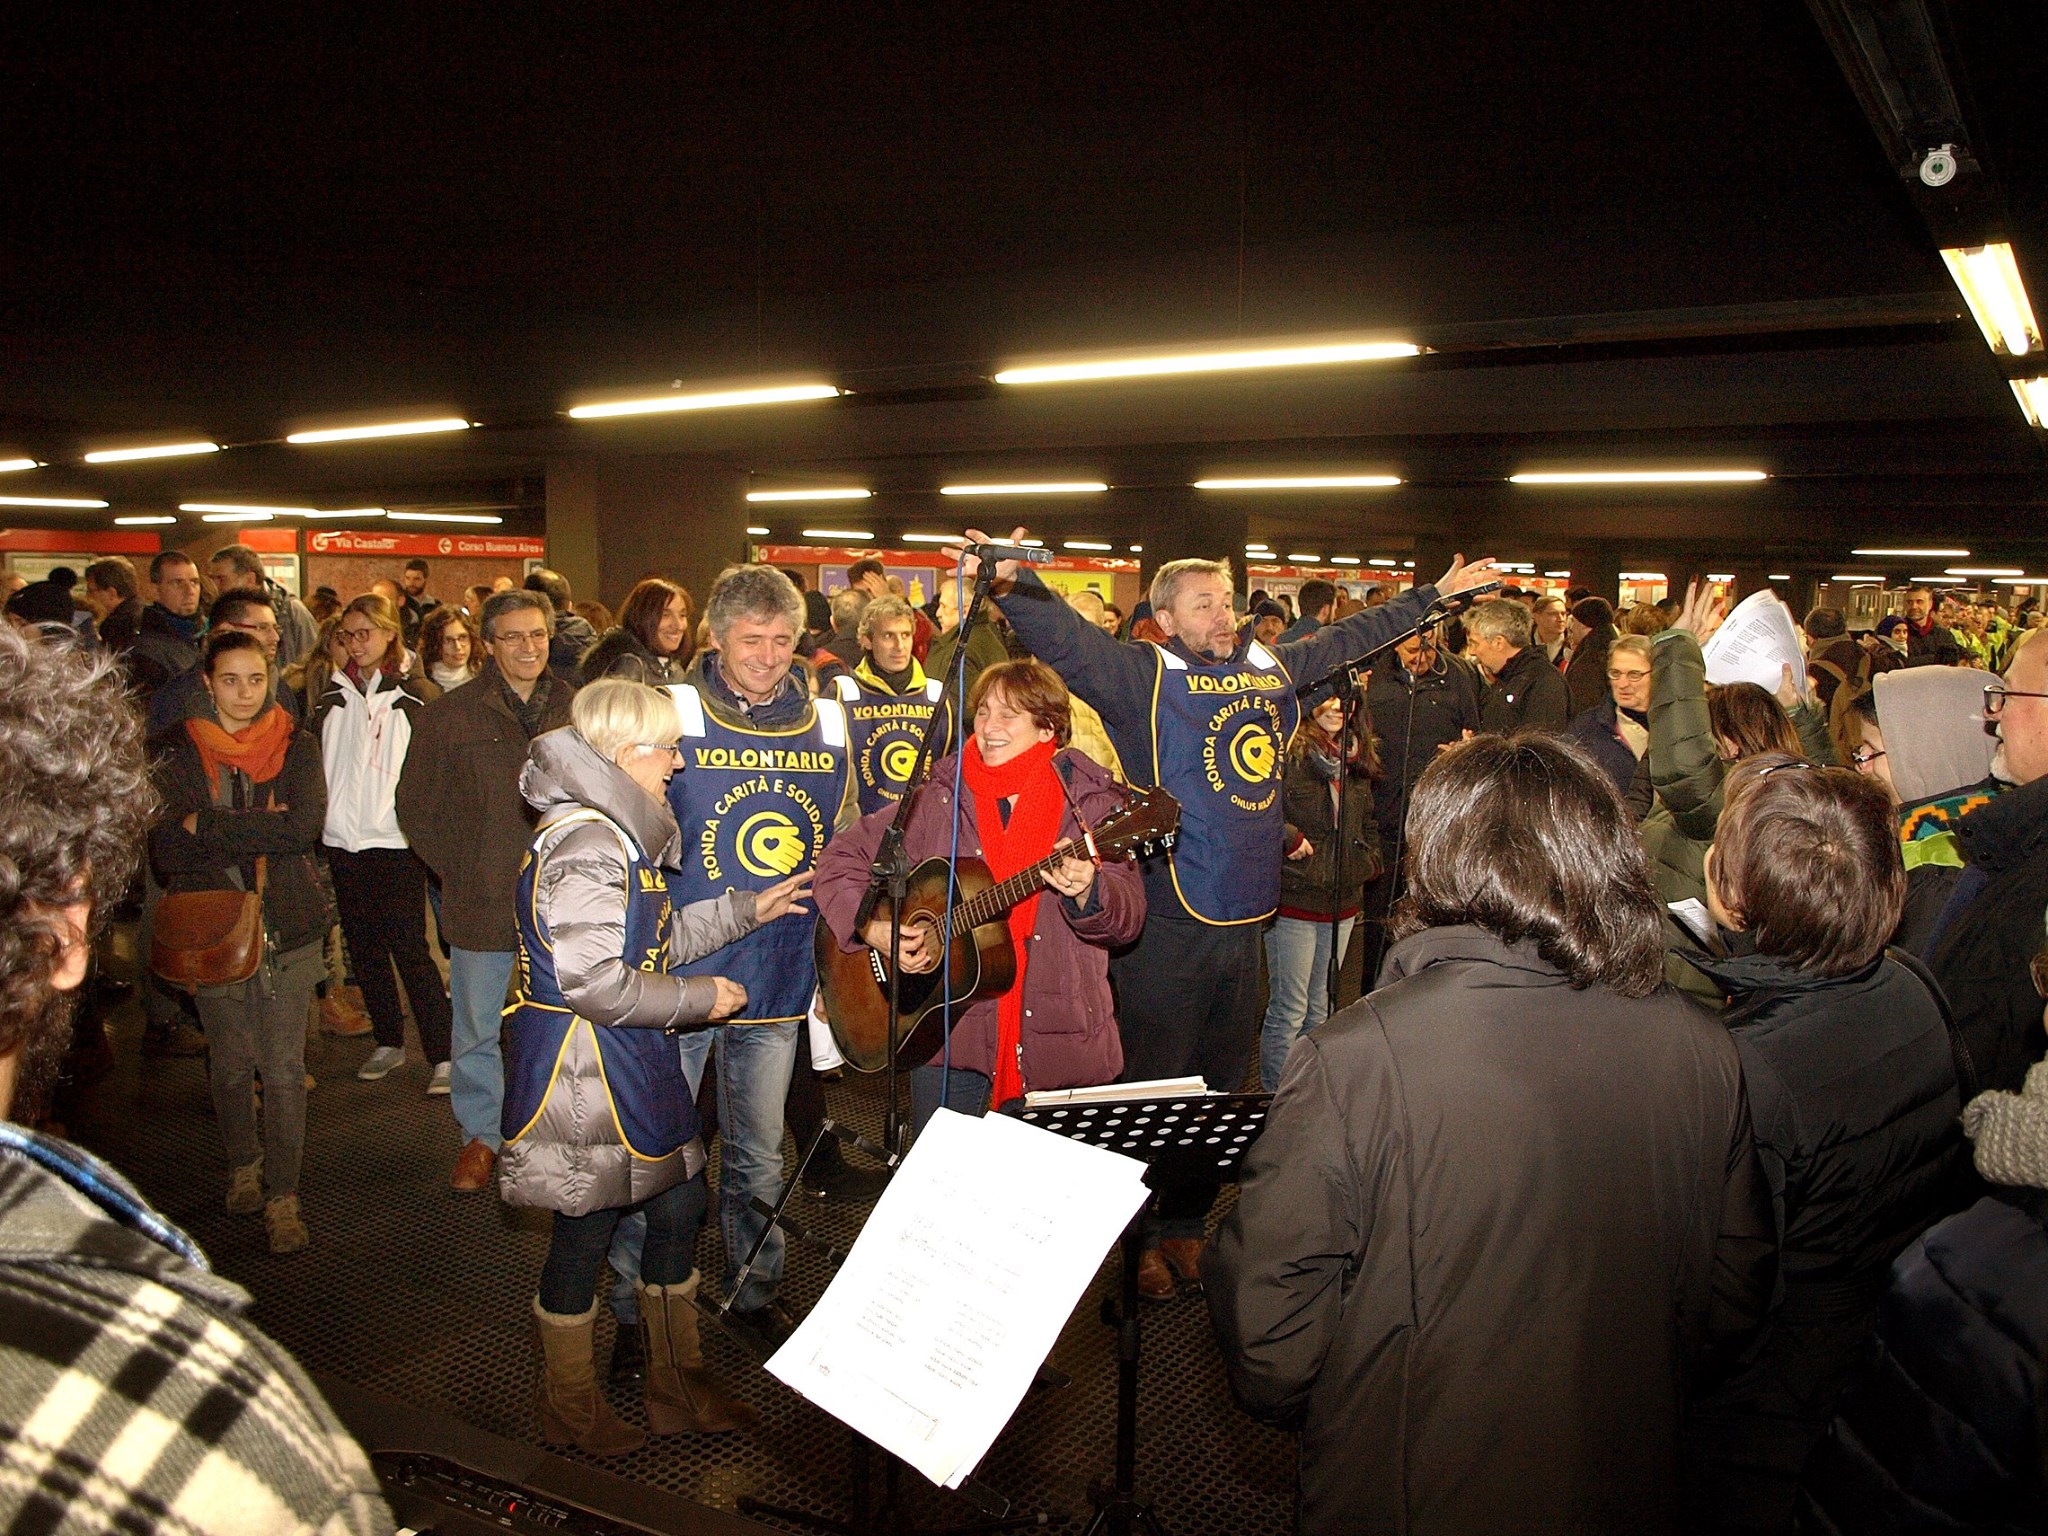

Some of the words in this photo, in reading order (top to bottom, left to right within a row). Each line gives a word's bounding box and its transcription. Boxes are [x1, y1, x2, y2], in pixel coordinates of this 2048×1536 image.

[335, 538, 352, 548] Via
[458, 541, 484, 552] Corso
[485, 541, 517, 553] Buenos
[518, 543, 539, 554] Aires
[1186, 672, 1281, 692] VOLONARIO
[853, 704, 934, 718] VOLONTARIO
[1253, 696, 1261, 709] E
[1208, 695, 1250, 732] CARITÀ
[866, 719, 900, 747] CARITÀ
[901, 721, 908, 731] E
[695, 748, 835, 770] VOLONTARIO
[861, 748, 875, 787] RONDA
[1203, 736, 1225, 793] RONDA
[1230, 795, 1257, 811] ONLUS
[701, 819, 722, 881] RONDA
[714, 775, 769, 815] CARITÀ
[773, 779, 784, 793] E
